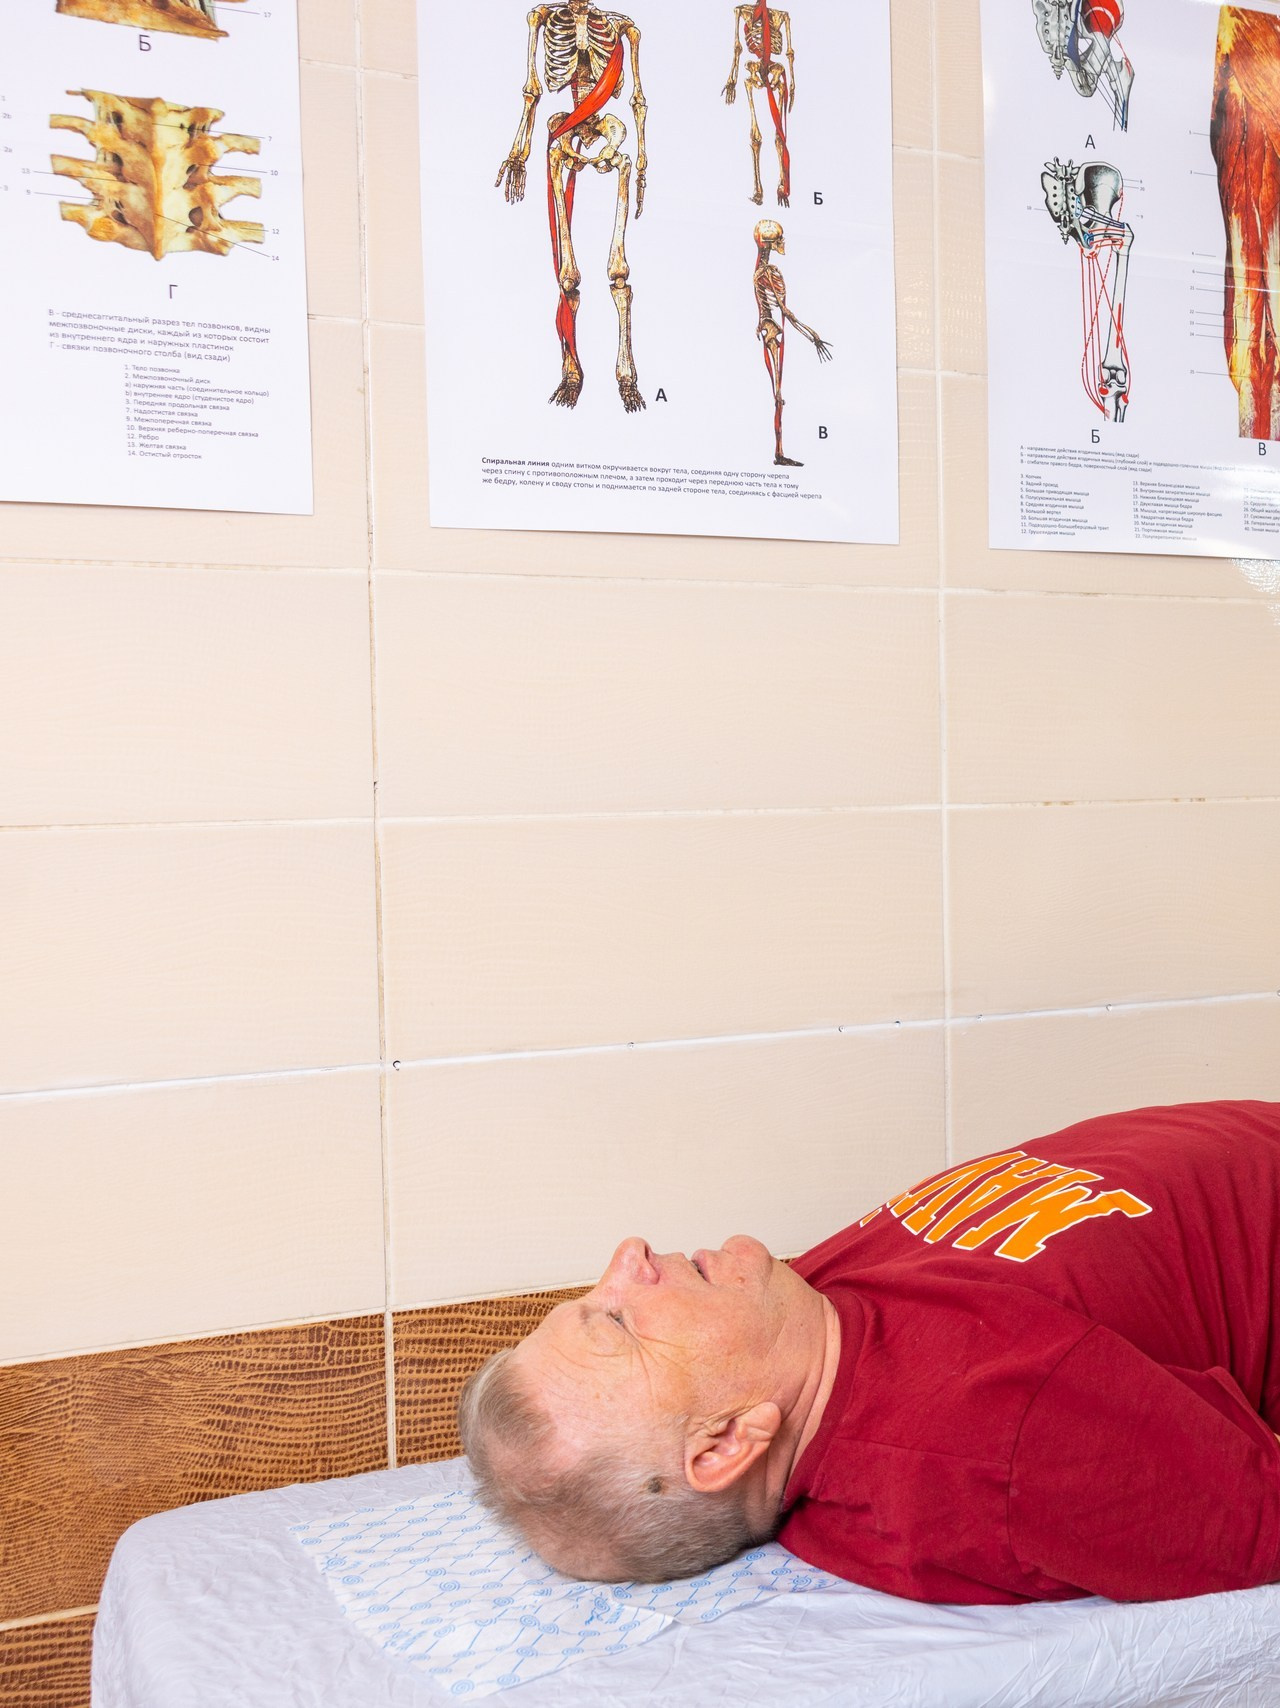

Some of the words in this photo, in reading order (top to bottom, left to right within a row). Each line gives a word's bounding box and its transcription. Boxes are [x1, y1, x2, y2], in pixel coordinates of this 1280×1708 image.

[139, 34, 151, 51] Б
[1084, 135, 1096, 149] А
[814, 192, 823, 205] Б
[169, 284, 178, 299] Г
[49, 321, 125, 332] межпозвоночные
[128, 327, 155, 336] диски,
[204, 333, 237, 341] которых
[198, 322, 242, 332] позвонков,
[62, 333, 115, 342] внутреннего
[148, 340, 190, 348] наружных
[192, 343, 234, 351] пластинок
[93, 346, 152, 356] позвоночного
[184, 352, 203, 360] (вид
[204, 354, 230, 363] сзади)
[656, 388, 668, 402] А
[818, 426, 828, 440] В
[1092, 429, 1100, 443] Б
[1258, 442, 1266, 455] В
[482, 457, 525, 466] Спиральная
[532, 471, 599, 479] противоположным
[494, 477, 517, 486] бедру,
[772, 490, 799, 499] фасцией
